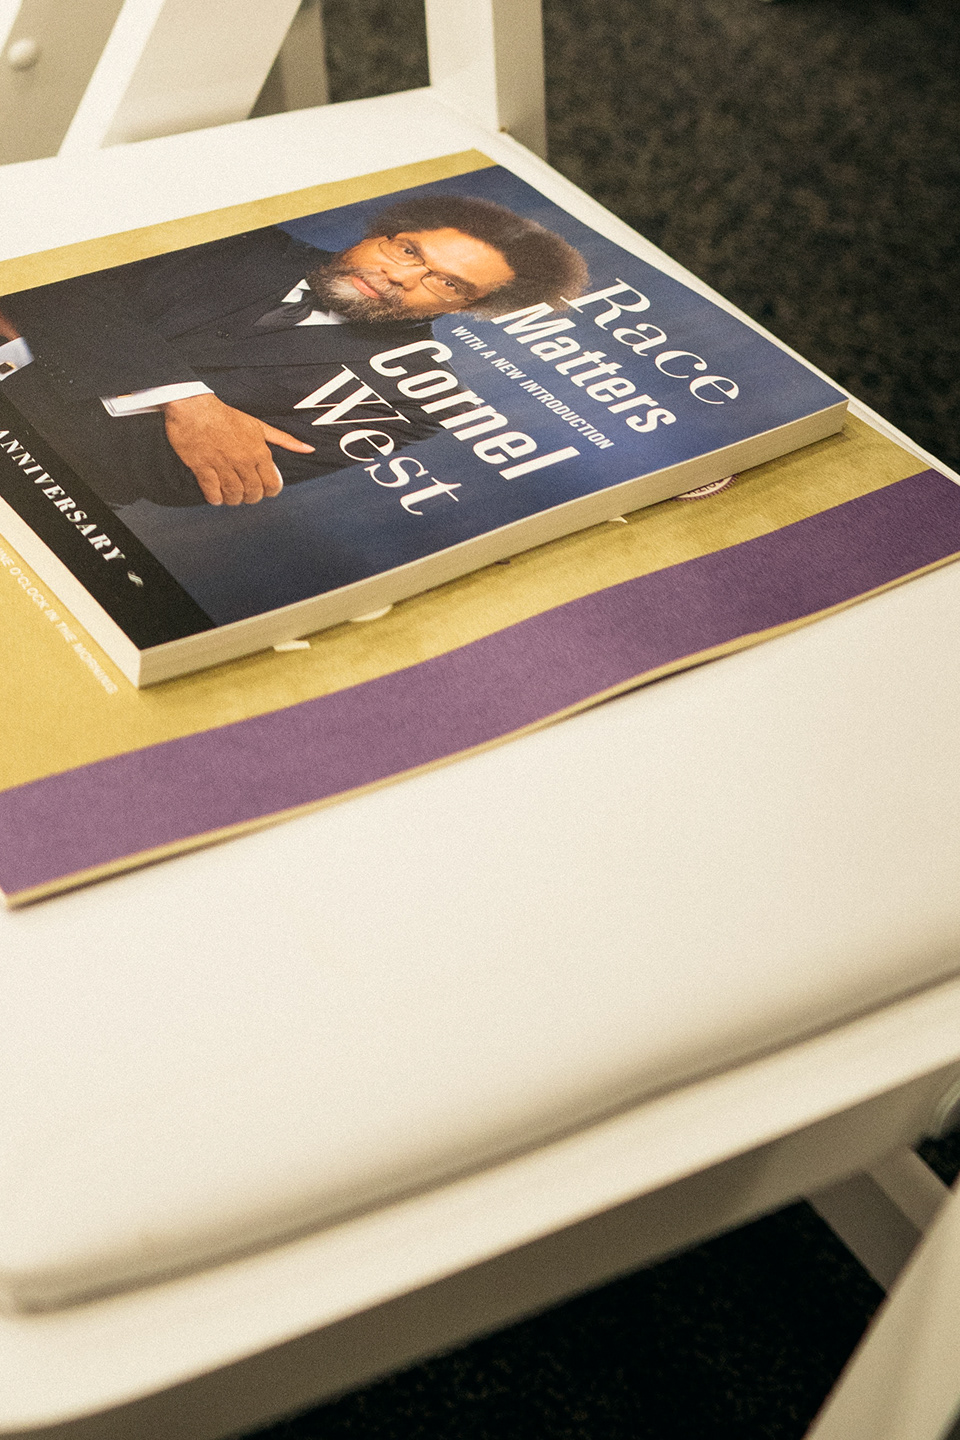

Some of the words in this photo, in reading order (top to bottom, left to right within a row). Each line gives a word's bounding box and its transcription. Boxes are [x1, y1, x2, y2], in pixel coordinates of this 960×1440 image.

[451, 326, 487, 351] WITH
[480, 350, 497, 359] A
[491, 358, 527, 380] NEW
[519, 379, 615, 449] INTRODUCTION
[490, 302, 677, 433] Matters
[560, 278, 740, 405] Race
[293, 364, 462, 515] West
[369, 340, 581, 480] Cornel
[9, 567, 50, 609] O'CLOCK
